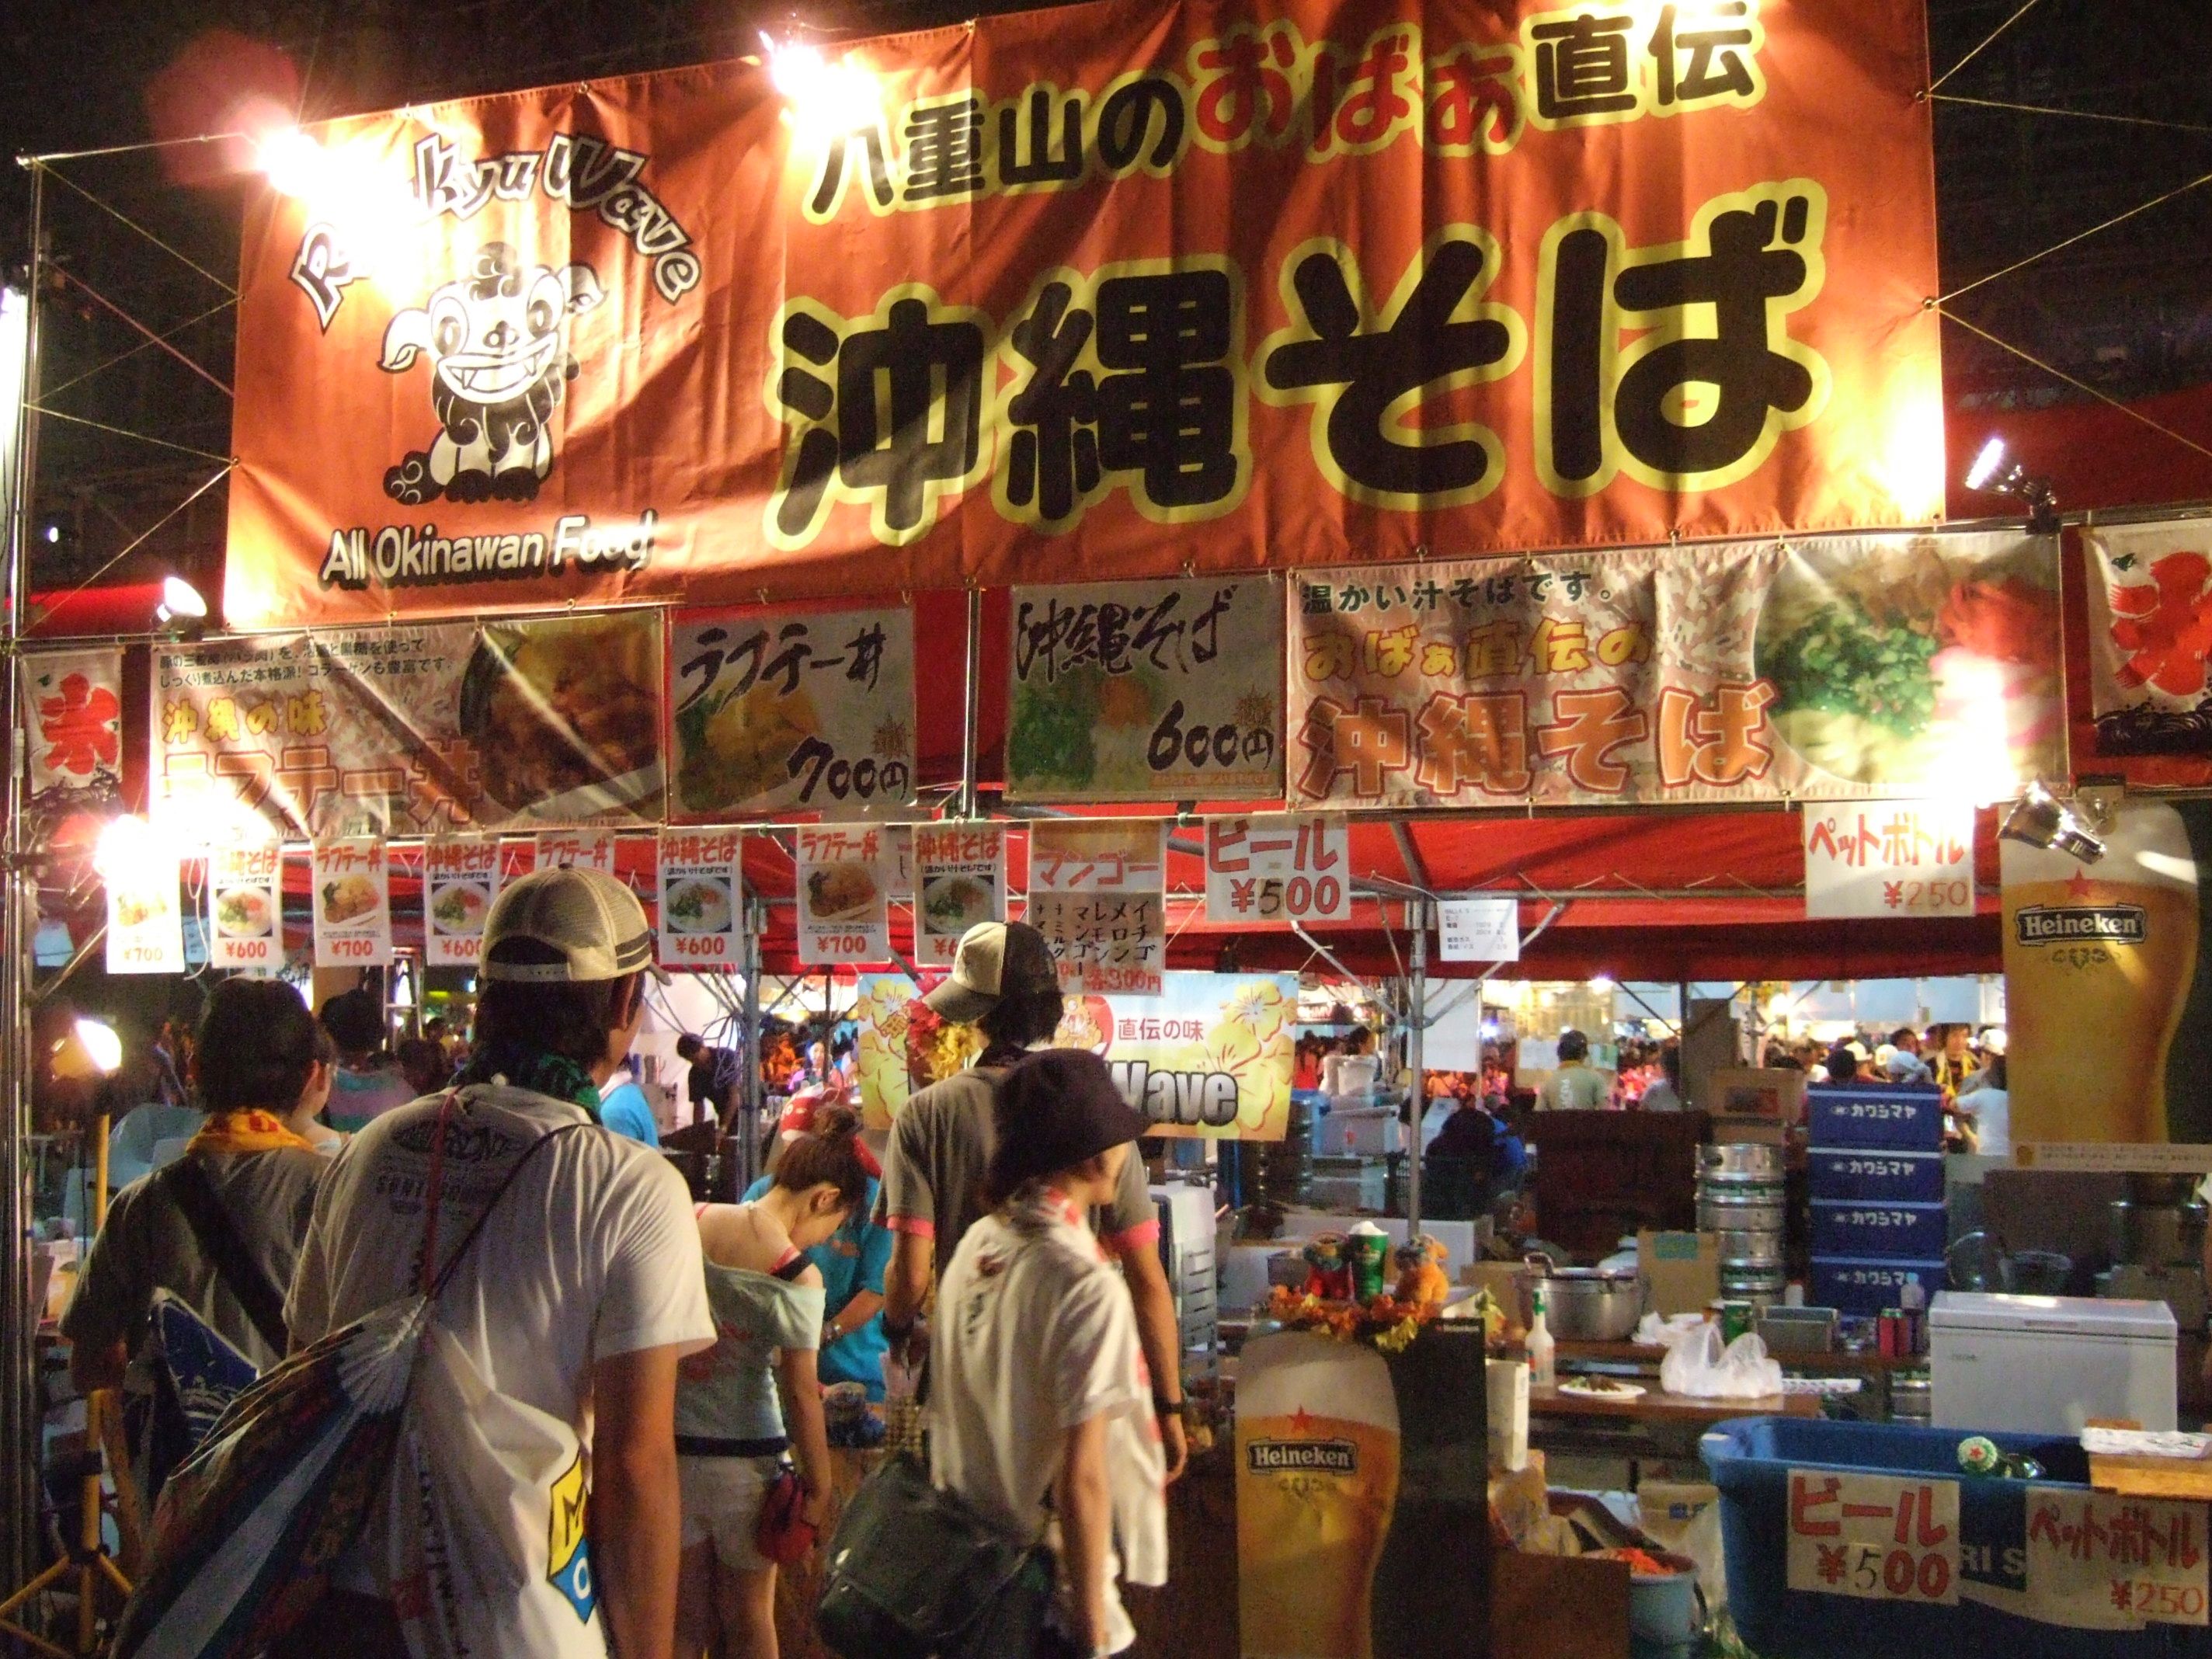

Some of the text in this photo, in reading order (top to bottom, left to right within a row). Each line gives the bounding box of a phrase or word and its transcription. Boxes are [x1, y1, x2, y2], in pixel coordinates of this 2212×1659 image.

[764, 179, 1831, 550] 沖縄そば
[318, 509, 658, 589] All Okinawan Food
[1303, 571, 1611, 615] 温かい汁そばです。
[1016, 584, 1240, 683] 沖縄そば
[1303, 617, 1651, 682] おばぁ直伝の
[162, 690, 328, 744] 沖縄の味
[1146, 698, 1275, 772] 600円
[1297, 678, 1779, 797] 沖縄そば
[787, 735, 908, 802] 700円
[660, 832, 737, 865] 沖縄そば
[915, 830, 1000, 863] 沖縄そば
[1206, 819, 1338, 873] ビール
[1809, 815, 1967, 868] ペットボトル
[1034, 849, 1160, 888] マンゴー
[1230, 876, 1341, 915] ¥500
[1883, 880, 1969, 909] ¥250
[676, 937, 725, 955] ¥600
[818, 935, 867, 954] ¥700
[2024, 913, 2137, 937] Heineken
[225, 941, 267, 958] ¥600
[331, 939, 374, 958] ¥700
[1118, 1017, 1205, 1042] 直伝の味
[1254, 1445, 1348, 1467] Heineken
[1792, 1475, 1948, 1548] ビール
[2030, 1505, 2200, 1570] ペットボトル
[1817, 1545, 1949, 1598] ¥500
[2110, 1579, 2205, 1616] ¥250
